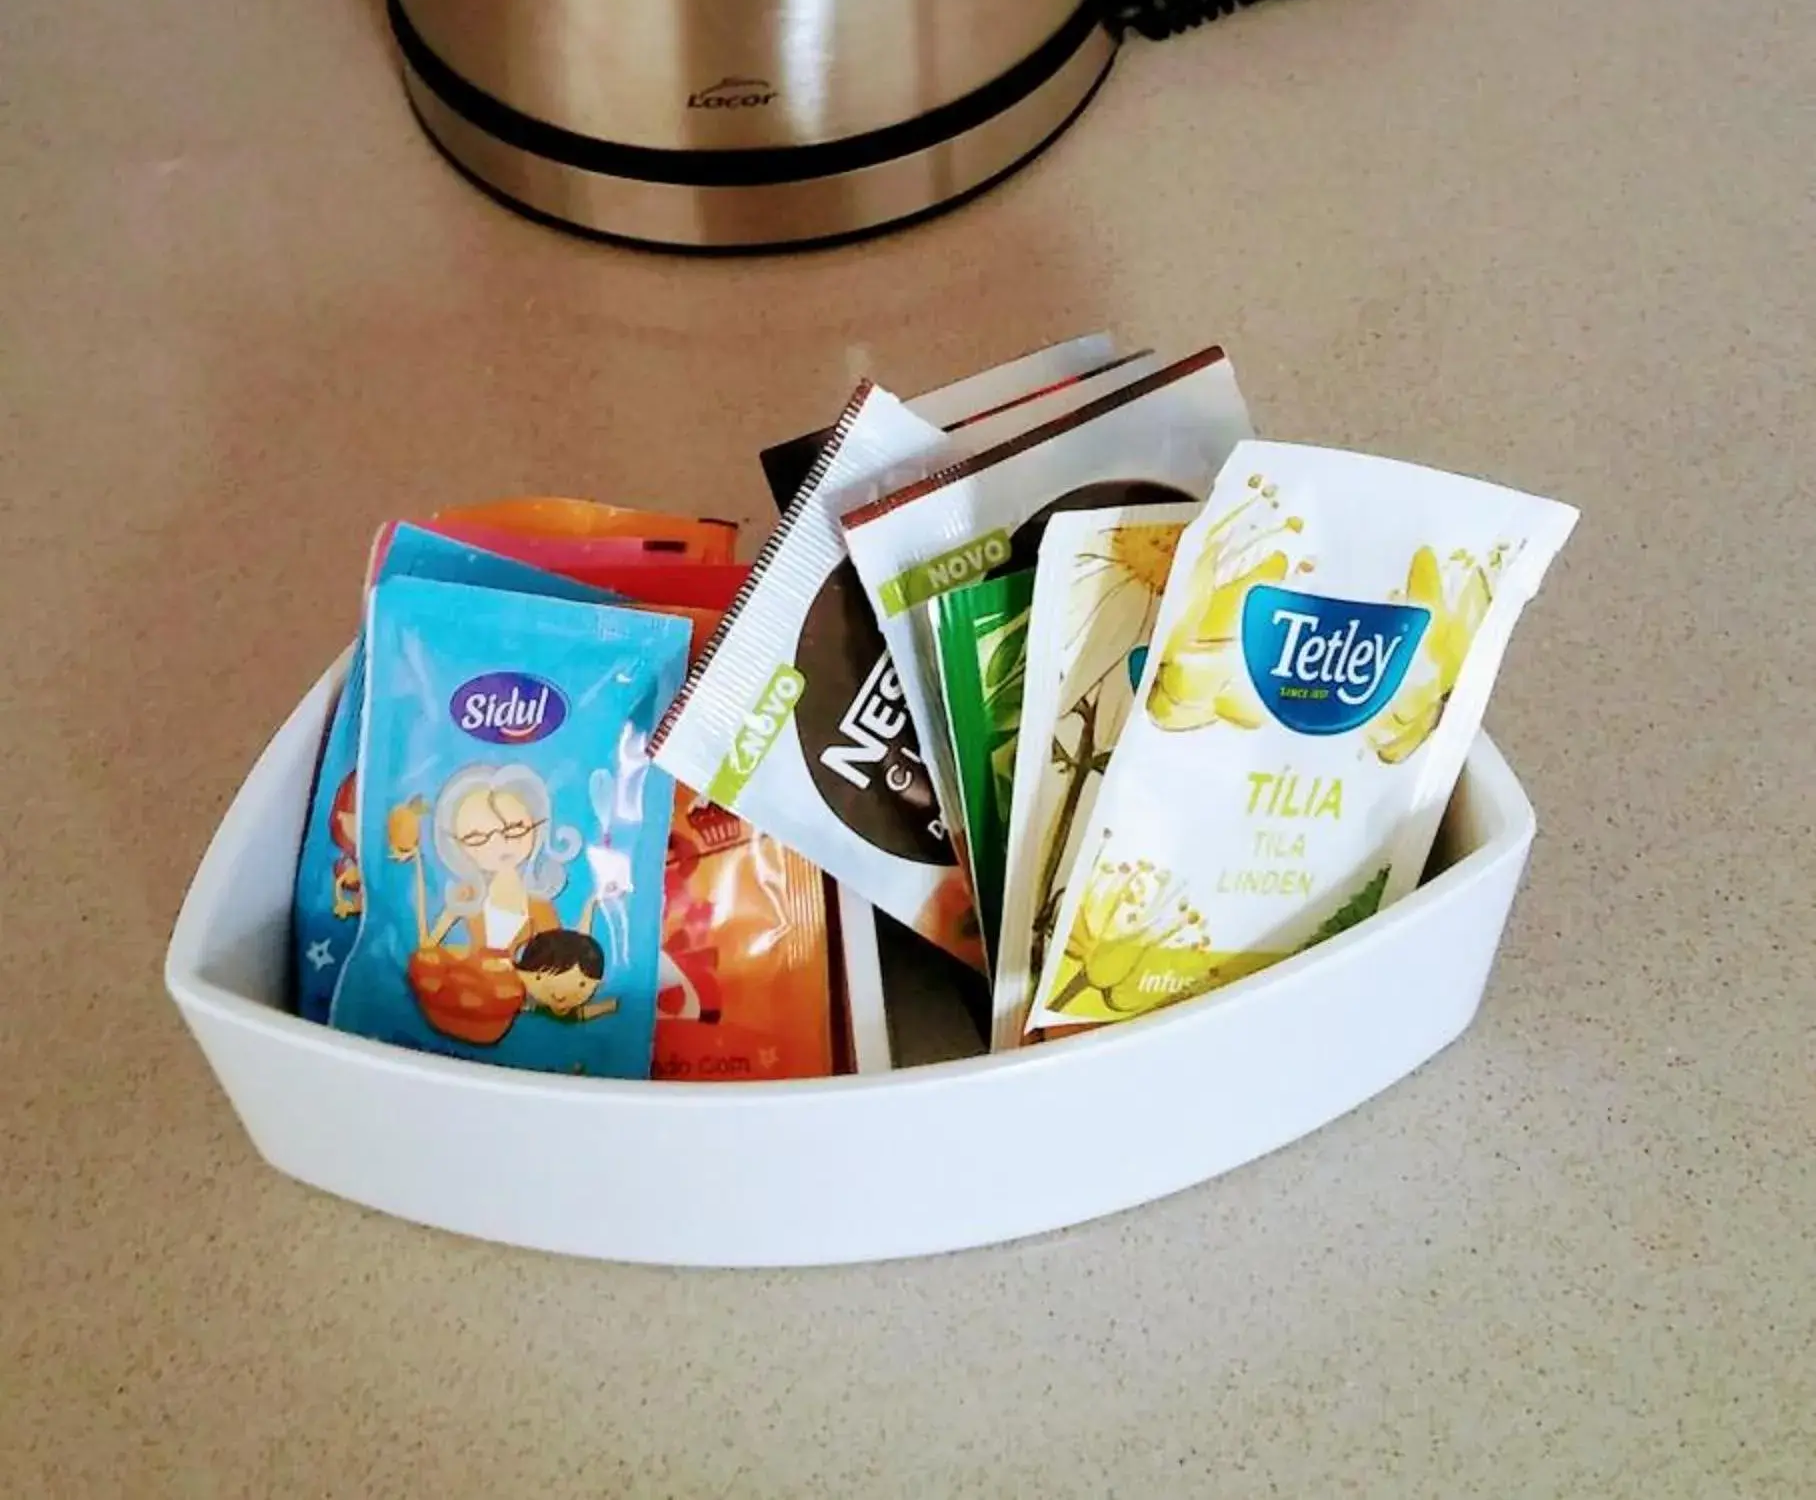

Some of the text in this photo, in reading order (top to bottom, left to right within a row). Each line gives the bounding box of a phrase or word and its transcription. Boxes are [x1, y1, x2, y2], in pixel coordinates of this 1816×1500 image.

[927, 539, 1005, 589] NOVO
[1269, 609, 1403, 706] Tetley
[461, 685, 549, 730] Sidul
[1247, 763, 1343, 820] TÍLIA
[1216, 867, 1315, 898] LINDEN
